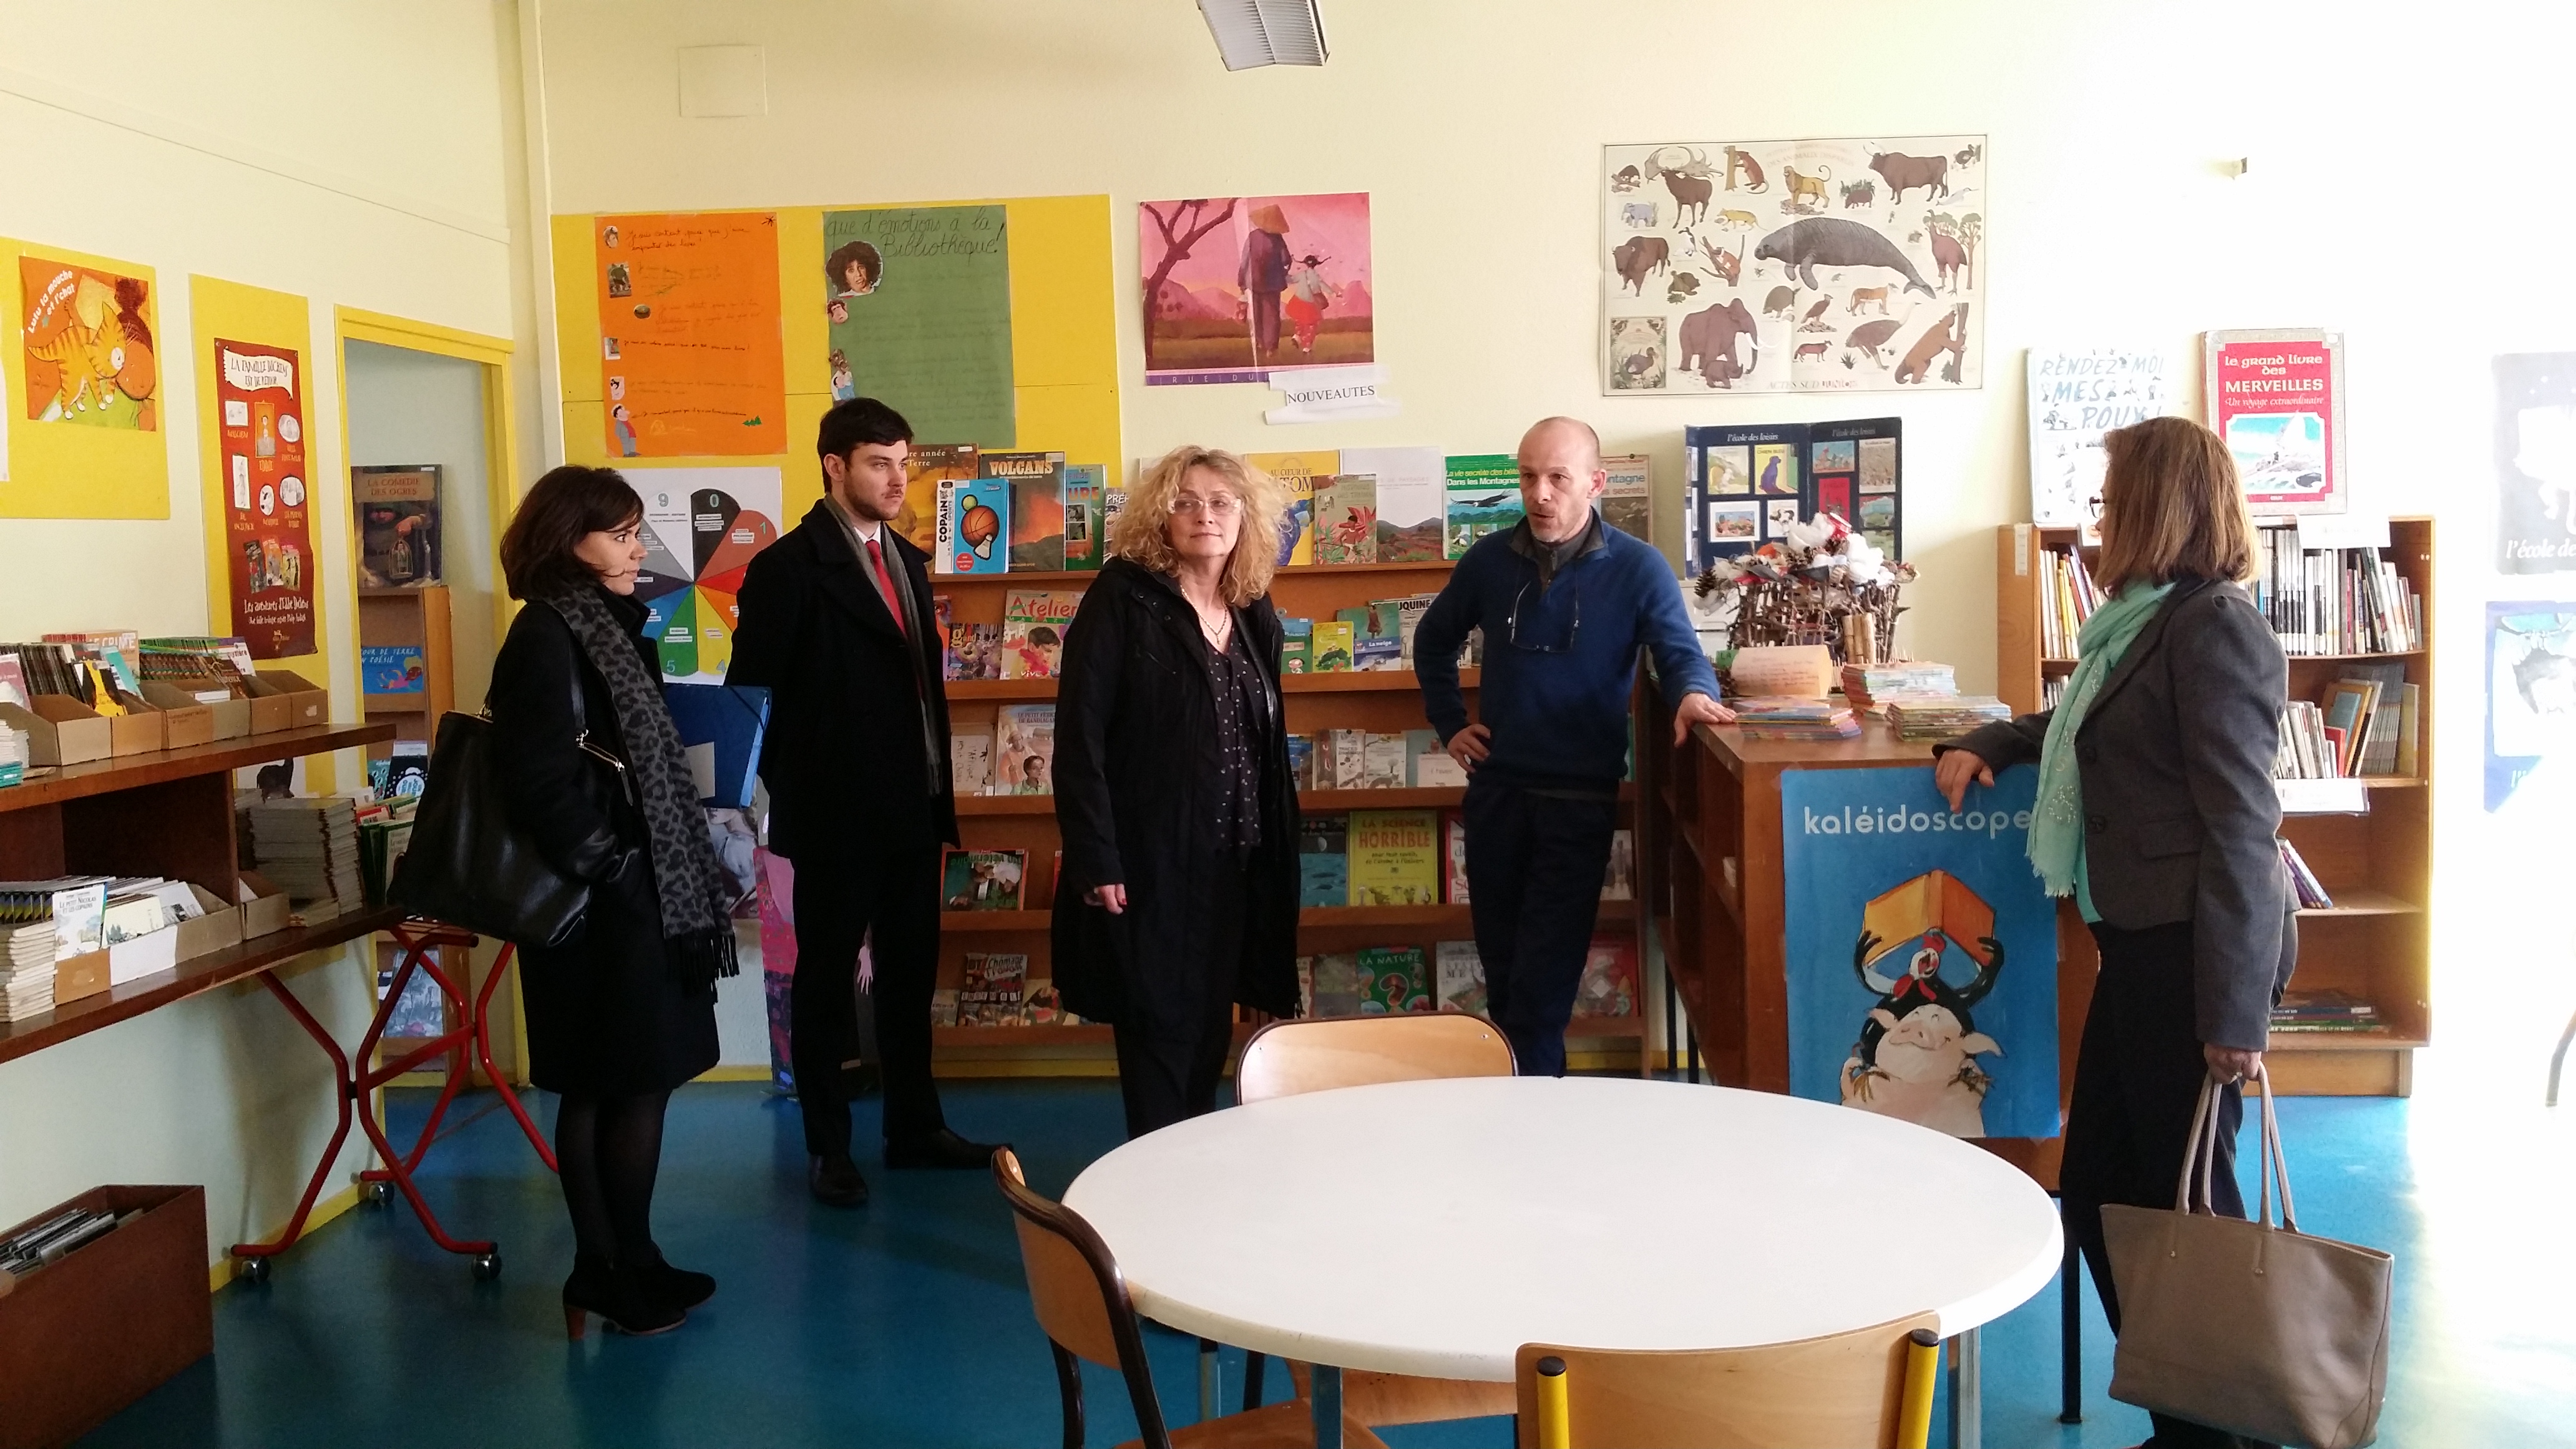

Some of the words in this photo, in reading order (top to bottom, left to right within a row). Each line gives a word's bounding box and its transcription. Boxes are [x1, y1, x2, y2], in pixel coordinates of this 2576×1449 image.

[826, 218, 856, 250] que
[972, 206, 991, 231] la
[27, 307, 42, 333] Lulu
[40, 293, 49, 306] la
[47, 270, 73, 295] mouche
[46, 302, 55, 315] et
[2131, 355, 2164, 374] MOI
[2225, 356, 2238, 366] le
[2242, 354, 2285, 369] grand
[2288, 354, 2323, 364] livre
[2261, 365, 2286, 375] des
[1173, 375, 1208, 383] RUE
[2225, 379, 2323, 393] MERVEILLES
[1287, 385, 1375, 404] NOUVEAUTES
[2052, 378, 2104, 403] MES
[2243, 398, 2268, 409] voyage
[2270, 395, 2325, 406] extraordinaire
[1727, 433, 1747, 442] l'école
[1748, 433, 1759, 441] des
[1759, 432, 1779, 441] loisirs
[920, 449, 946, 457] année
[990, 460, 1054, 476] VOLCANS
[1302, 467, 1312, 476] DE
[1479, 477, 1520, 485] Montagnes
[389, 487, 417, 495] OGRES
[1612, 487, 1646, 495] secrets
[658, 492, 670, 507] 9
[709, 494, 720, 508] 0
[759, 521, 766, 535] 1
[2506, 537, 2555, 559] l'école
[2557, 537, 2576, 557] de
[244, 598, 253, 613] Les
[255, 600, 278, 612] aventures
[102, 636, 136, 649] CRIME
[393, 647, 415, 655] TERRE
[369, 655, 394, 663] POÉSIE
[716, 659, 726, 673] 4
[666, 660, 676, 673] 5
[1362, 819, 1375, 829] LA
[1382, 817, 1425, 828] SCIENCE
[1803, 804, 2031, 839] kaléidoscope
[1359, 829, 1430, 849] HORRIBLE
[66, 899, 77, 907] PETIT
[1359, 955, 1373, 966] LA
[1377, 953, 1420, 965] NATURE
